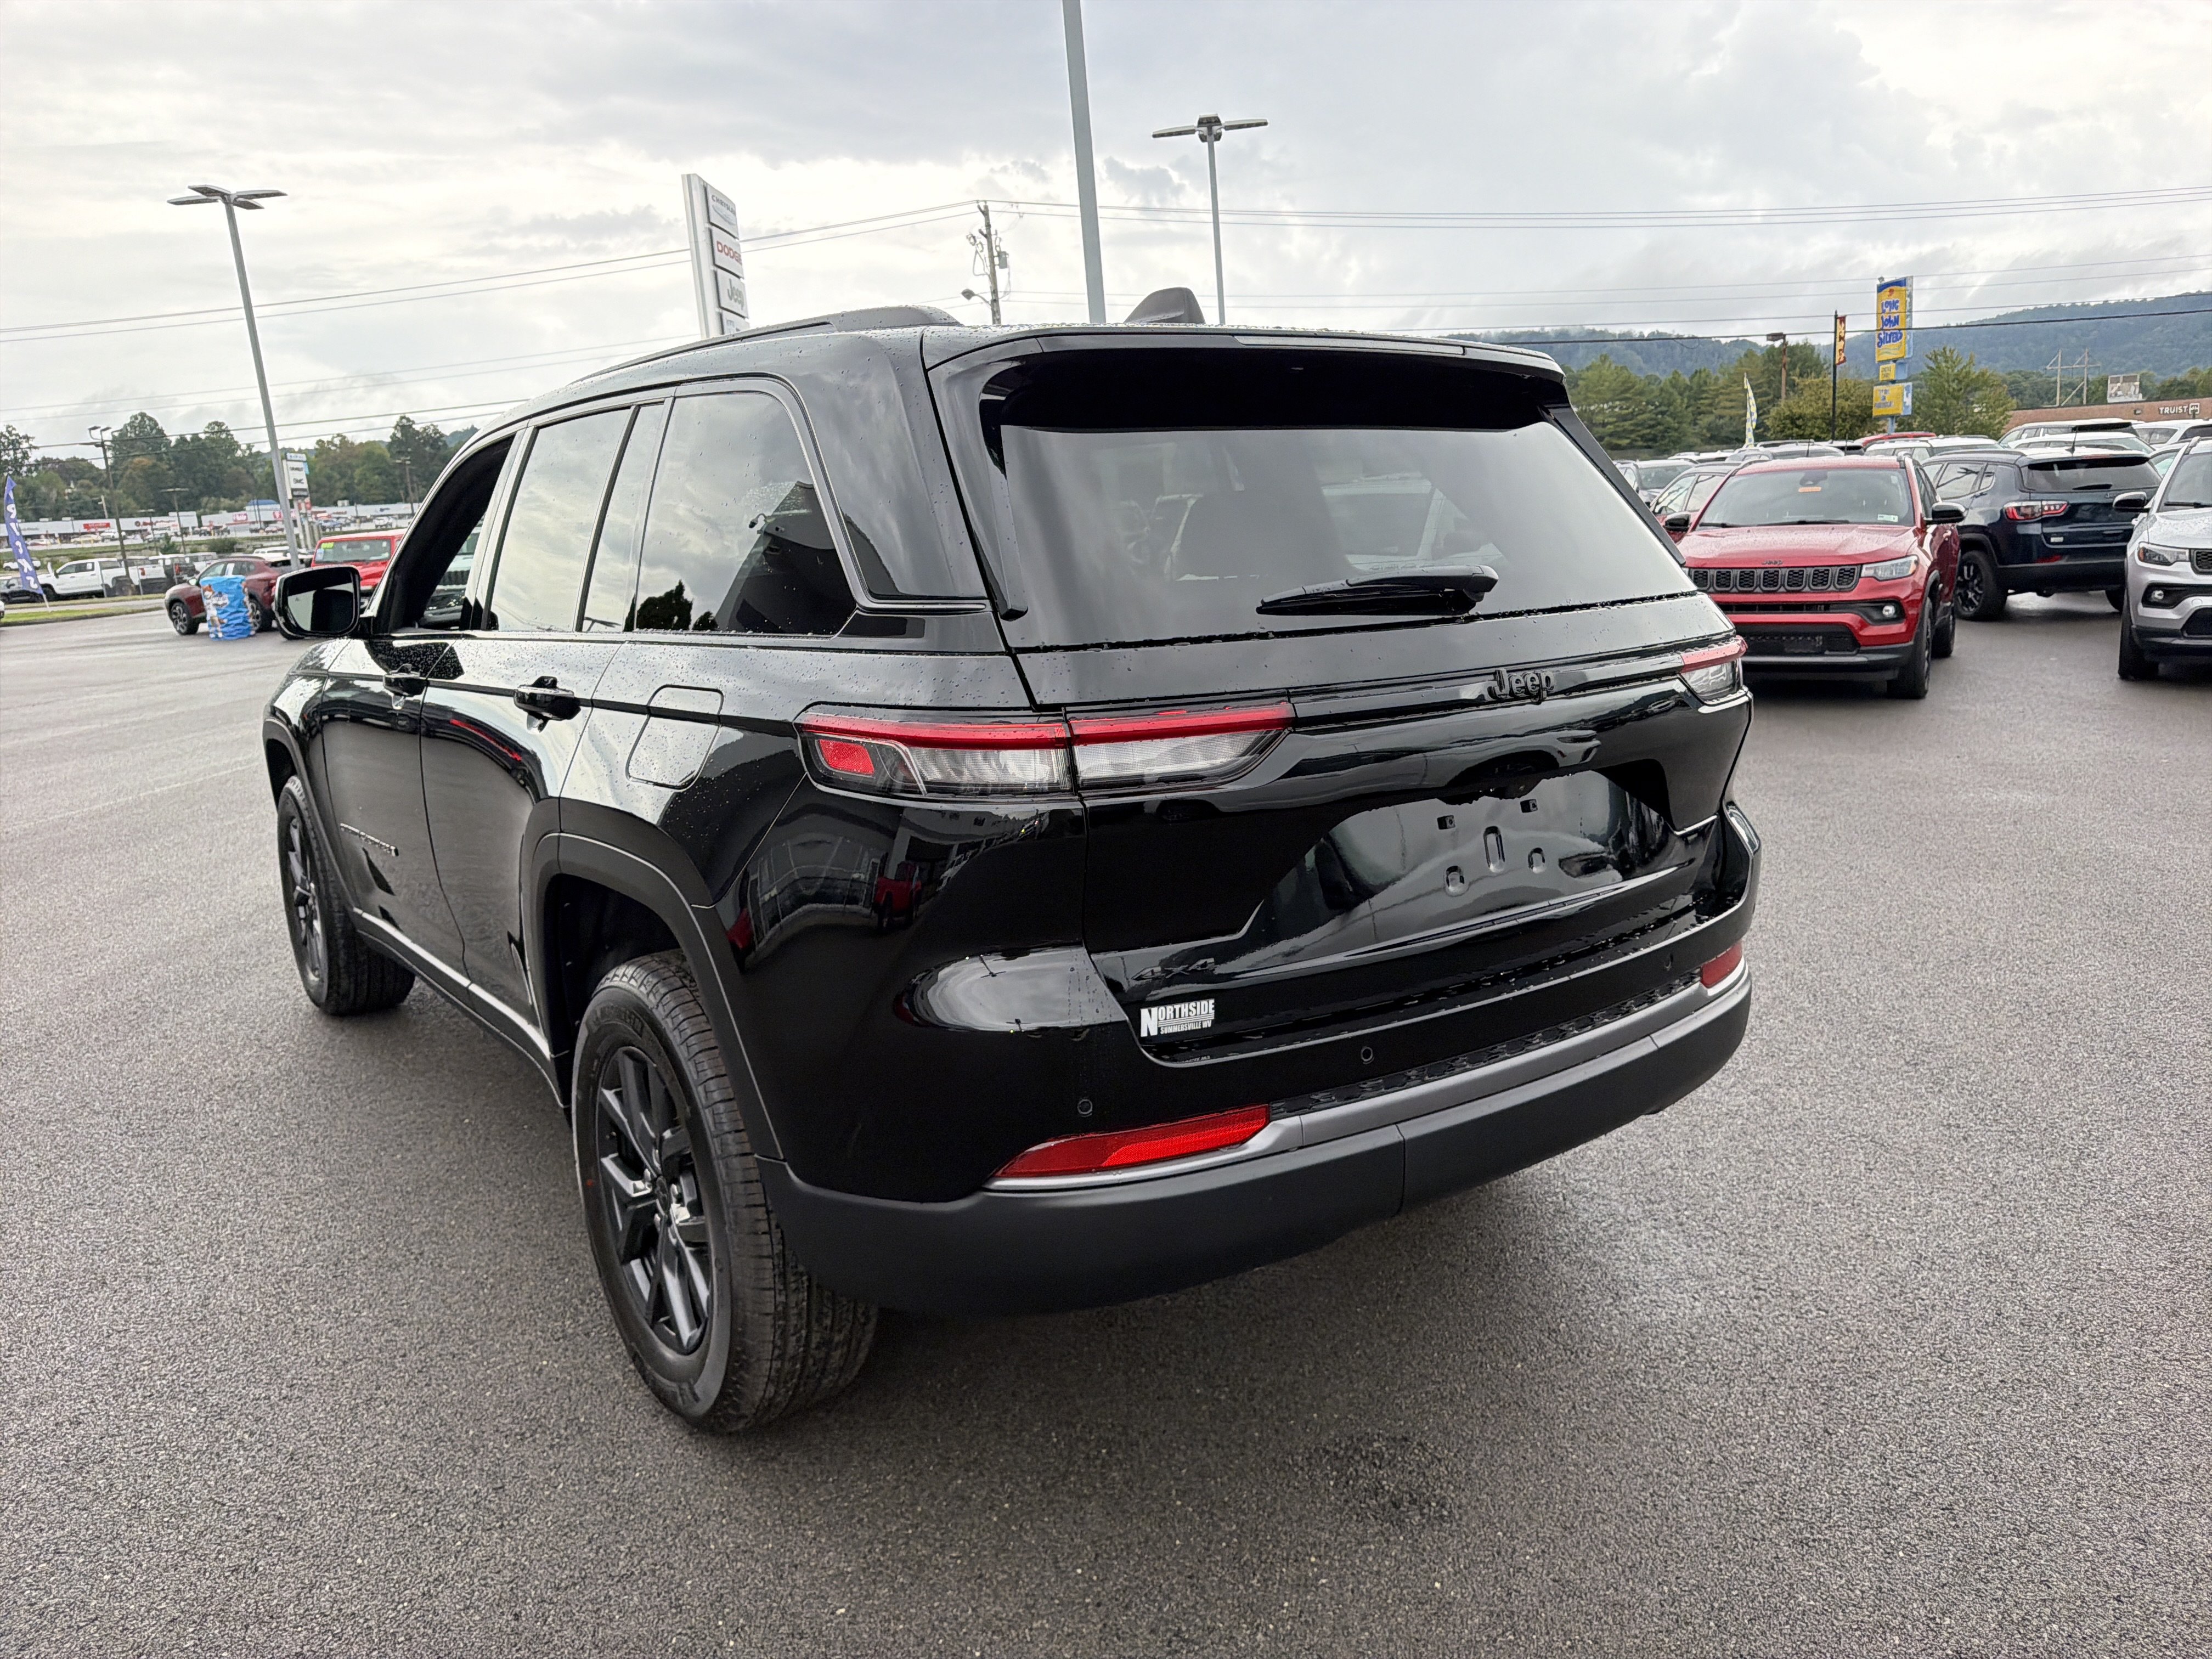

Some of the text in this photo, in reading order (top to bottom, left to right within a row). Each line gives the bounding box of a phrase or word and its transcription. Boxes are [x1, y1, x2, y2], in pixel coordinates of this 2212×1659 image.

[716, 240, 742, 264] DODGE
[727, 278, 744, 311] Jeep
[2159, 405, 2188, 414] TRUIST
[1488, 669, 1554, 704] Jeep
[1141, 998, 1215, 1037] NORTHSIDE
[1160, 1019, 1212, 1034] SUMMERSVILLE WV
